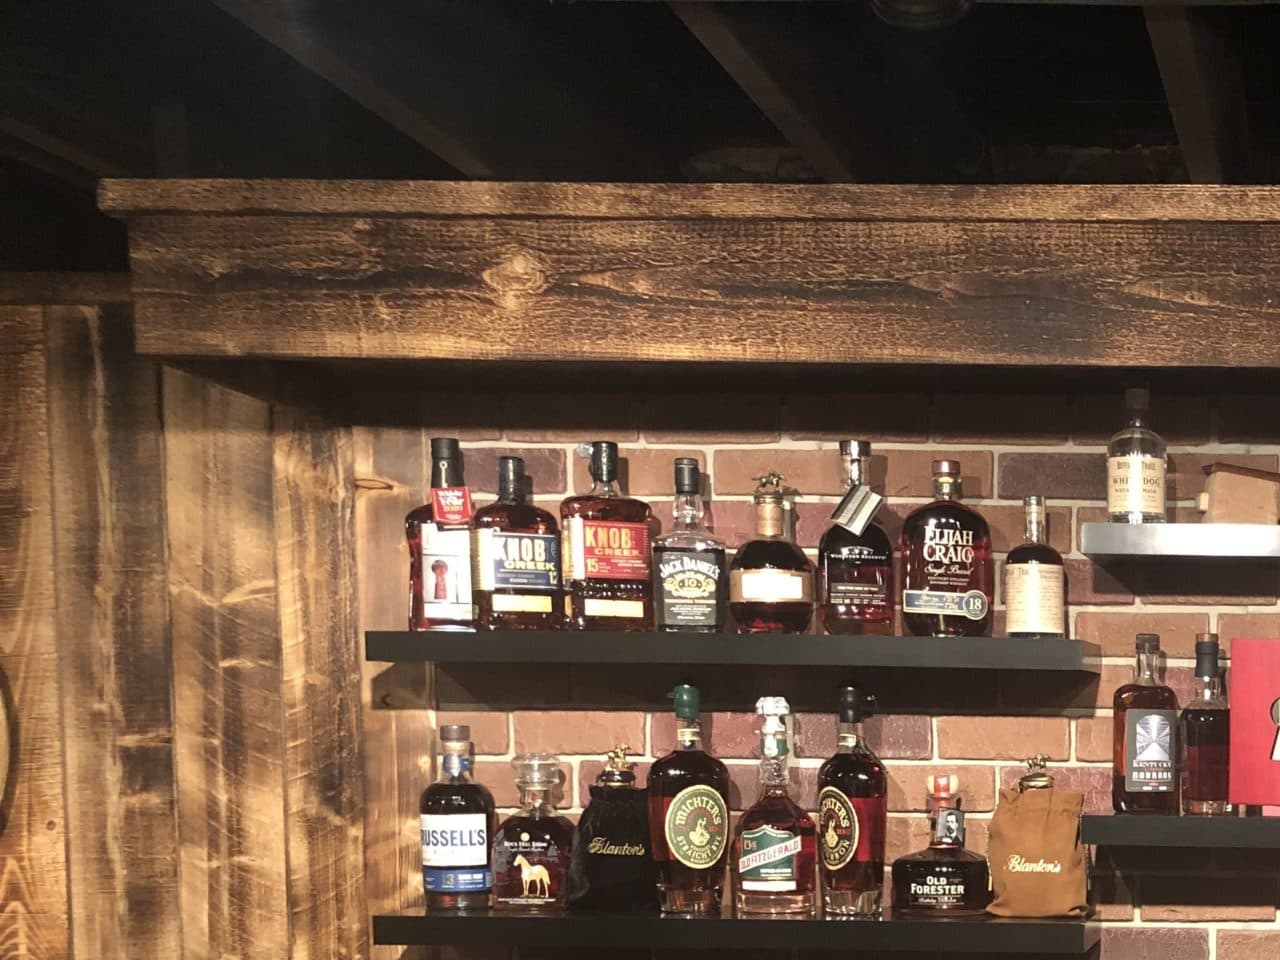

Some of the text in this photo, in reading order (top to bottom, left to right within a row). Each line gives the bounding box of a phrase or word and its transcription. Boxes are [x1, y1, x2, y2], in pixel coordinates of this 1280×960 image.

[1143, 477, 1160, 487] DOG
[585, 526, 632, 548] KNOB
[924, 525, 973, 545] ELIJAH
[493, 536, 546, 562] KNOB
[594, 547, 640, 557] CREEK
[923, 543, 974, 564] CRAIG
[503, 560, 556, 571] CREEK
[586, 558, 598, 573] 15
[659, 558, 681, 579] JACK
[683, 578, 698, 587] 10
[968, 598, 982, 611] 18
[1132, 760, 1172, 768] KENTUCKY
[676, 796, 722, 826] MICHTER'S
[421, 829, 486, 847] USSELL'S
[587, 836, 646, 856] Blanton's
[1008, 854, 1062, 874] Blanton's
[926, 875, 947, 886] OLD
[910, 883, 965, 895] FORESTER
